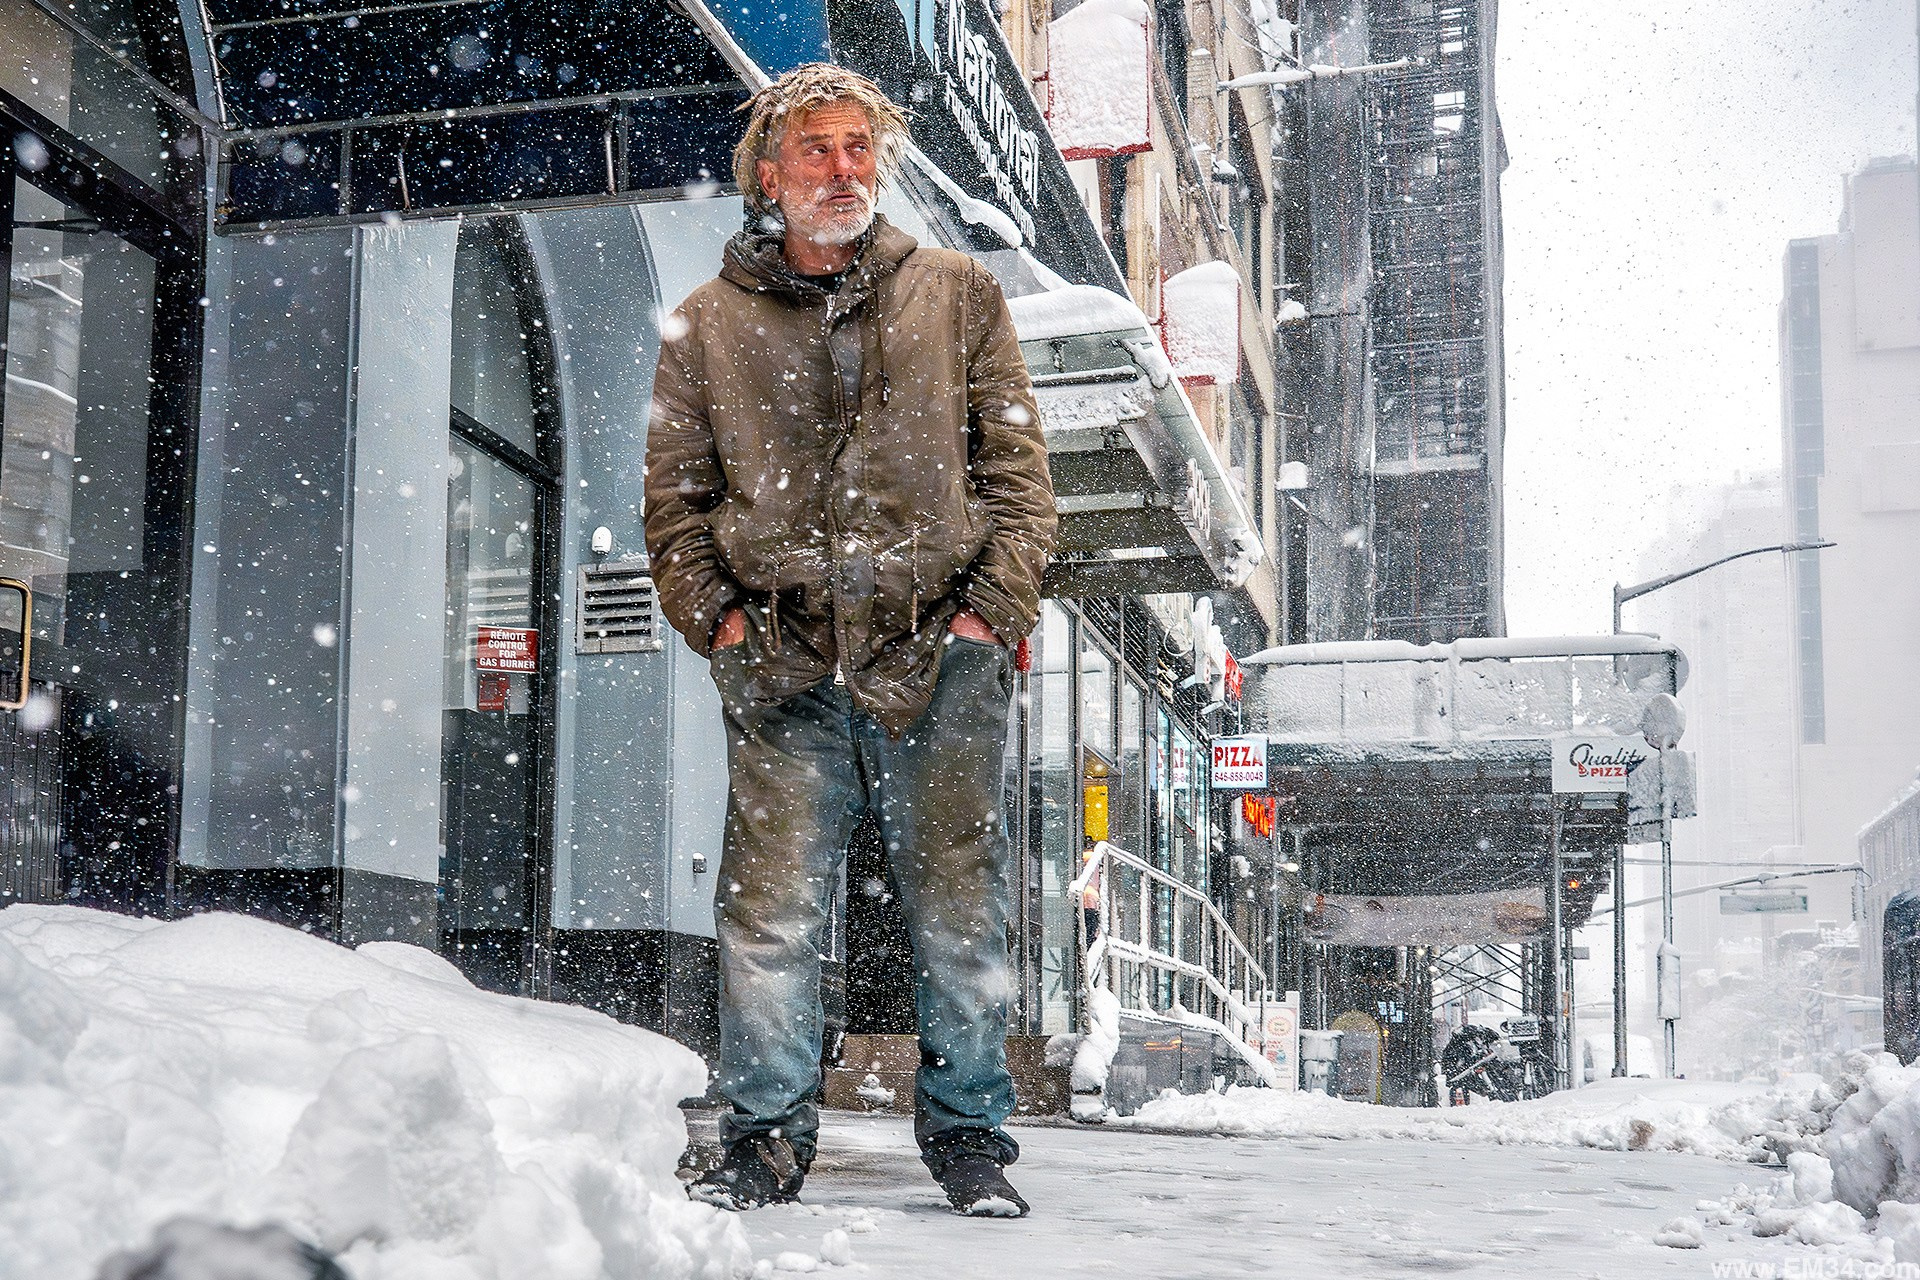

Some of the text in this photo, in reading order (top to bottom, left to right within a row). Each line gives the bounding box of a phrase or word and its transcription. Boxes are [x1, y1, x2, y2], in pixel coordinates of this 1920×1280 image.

[948, 0, 1039, 209] National
[490, 631, 527, 642] REMOTE
[488, 640, 528, 651] CONTROL
[499, 649, 516, 659] FOR
[479, 657, 535, 669] GAS BURNER
[1214, 746, 1263, 768] PIZZA
[1569, 743, 1647, 767] Quality
